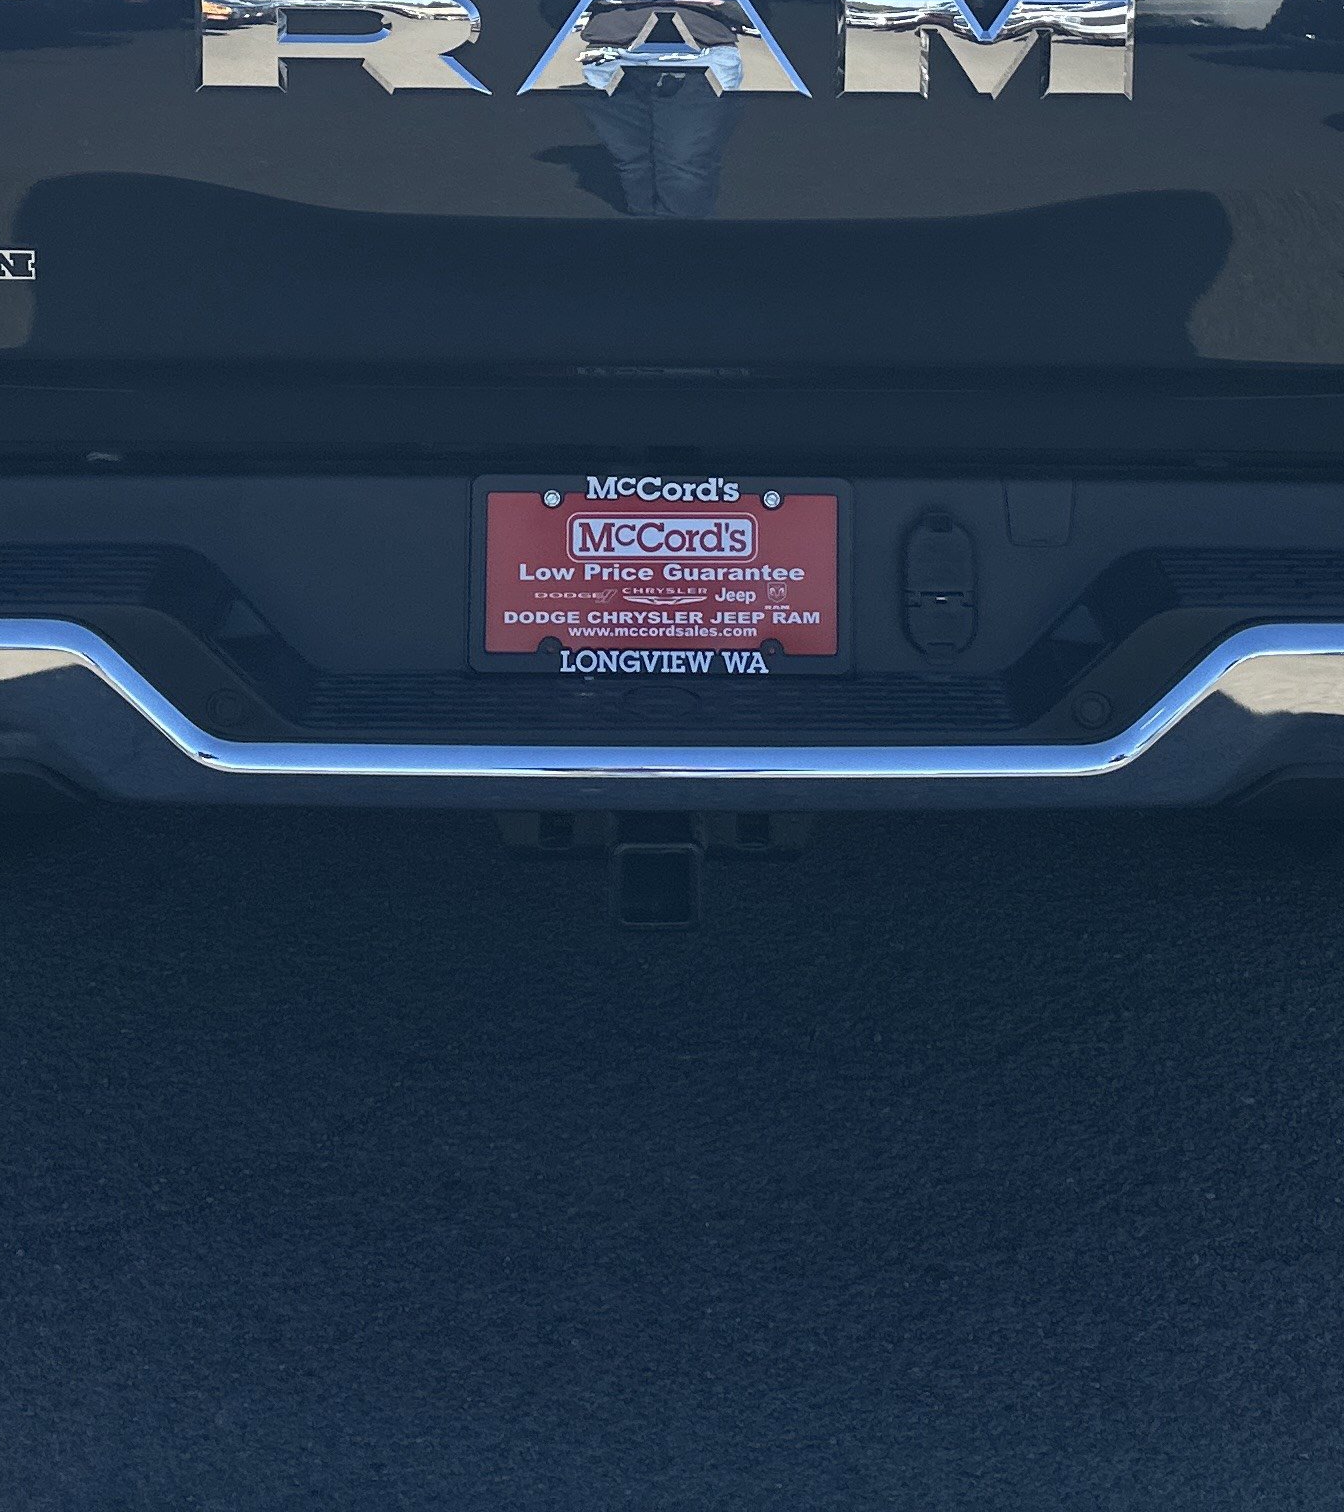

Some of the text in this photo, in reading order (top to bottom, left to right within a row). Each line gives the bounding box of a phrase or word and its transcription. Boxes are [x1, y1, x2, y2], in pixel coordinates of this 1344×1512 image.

[586, 475, 740, 503] McCord's
[578, 521, 747, 554] McCord's
[518, 563, 805, 582] Low Price Guarantee
[534, 591, 601, 599] DODGE
[621, 587, 708, 595] CHRYSLER
[714, 587, 757, 604] Jeep
[504, 611, 820, 624] DODGE CHRYSLER JEEP RAM
[568, 625, 757, 638] www.mccordsales.com
[559, 648, 769, 675] LONGVIEW WA
